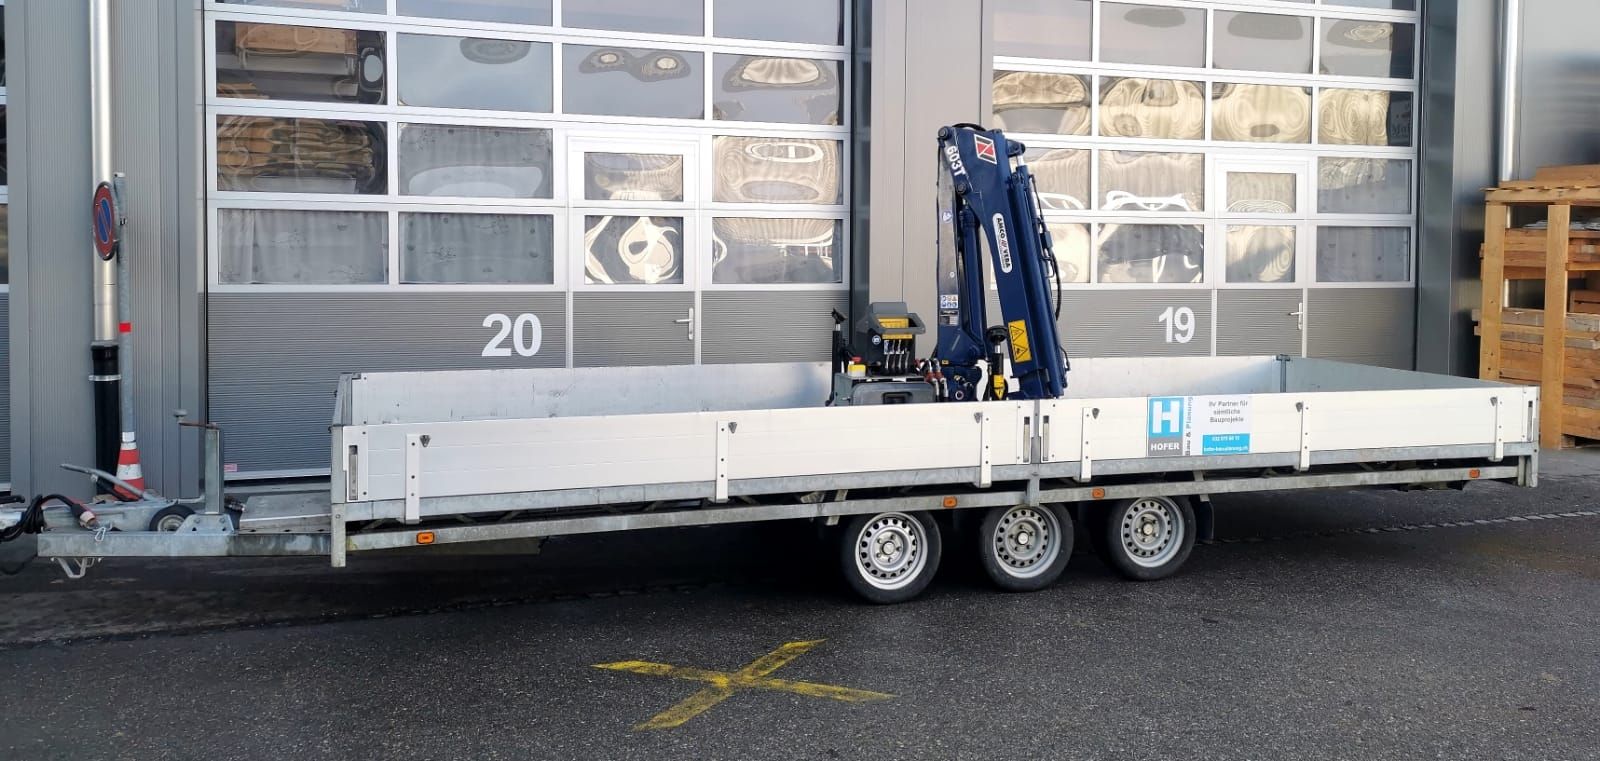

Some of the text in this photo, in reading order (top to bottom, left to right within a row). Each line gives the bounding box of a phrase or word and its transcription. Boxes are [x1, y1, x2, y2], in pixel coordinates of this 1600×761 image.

[946, 145, 966, 176] 603T
[481, 313, 542, 357] 20
[1158, 306, 1195, 344] 19
[1152, 400, 1180, 433] H
[1209, 416, 1244, 424] Bauprojekte
[1150, 442, 1180, 451] HOFER
